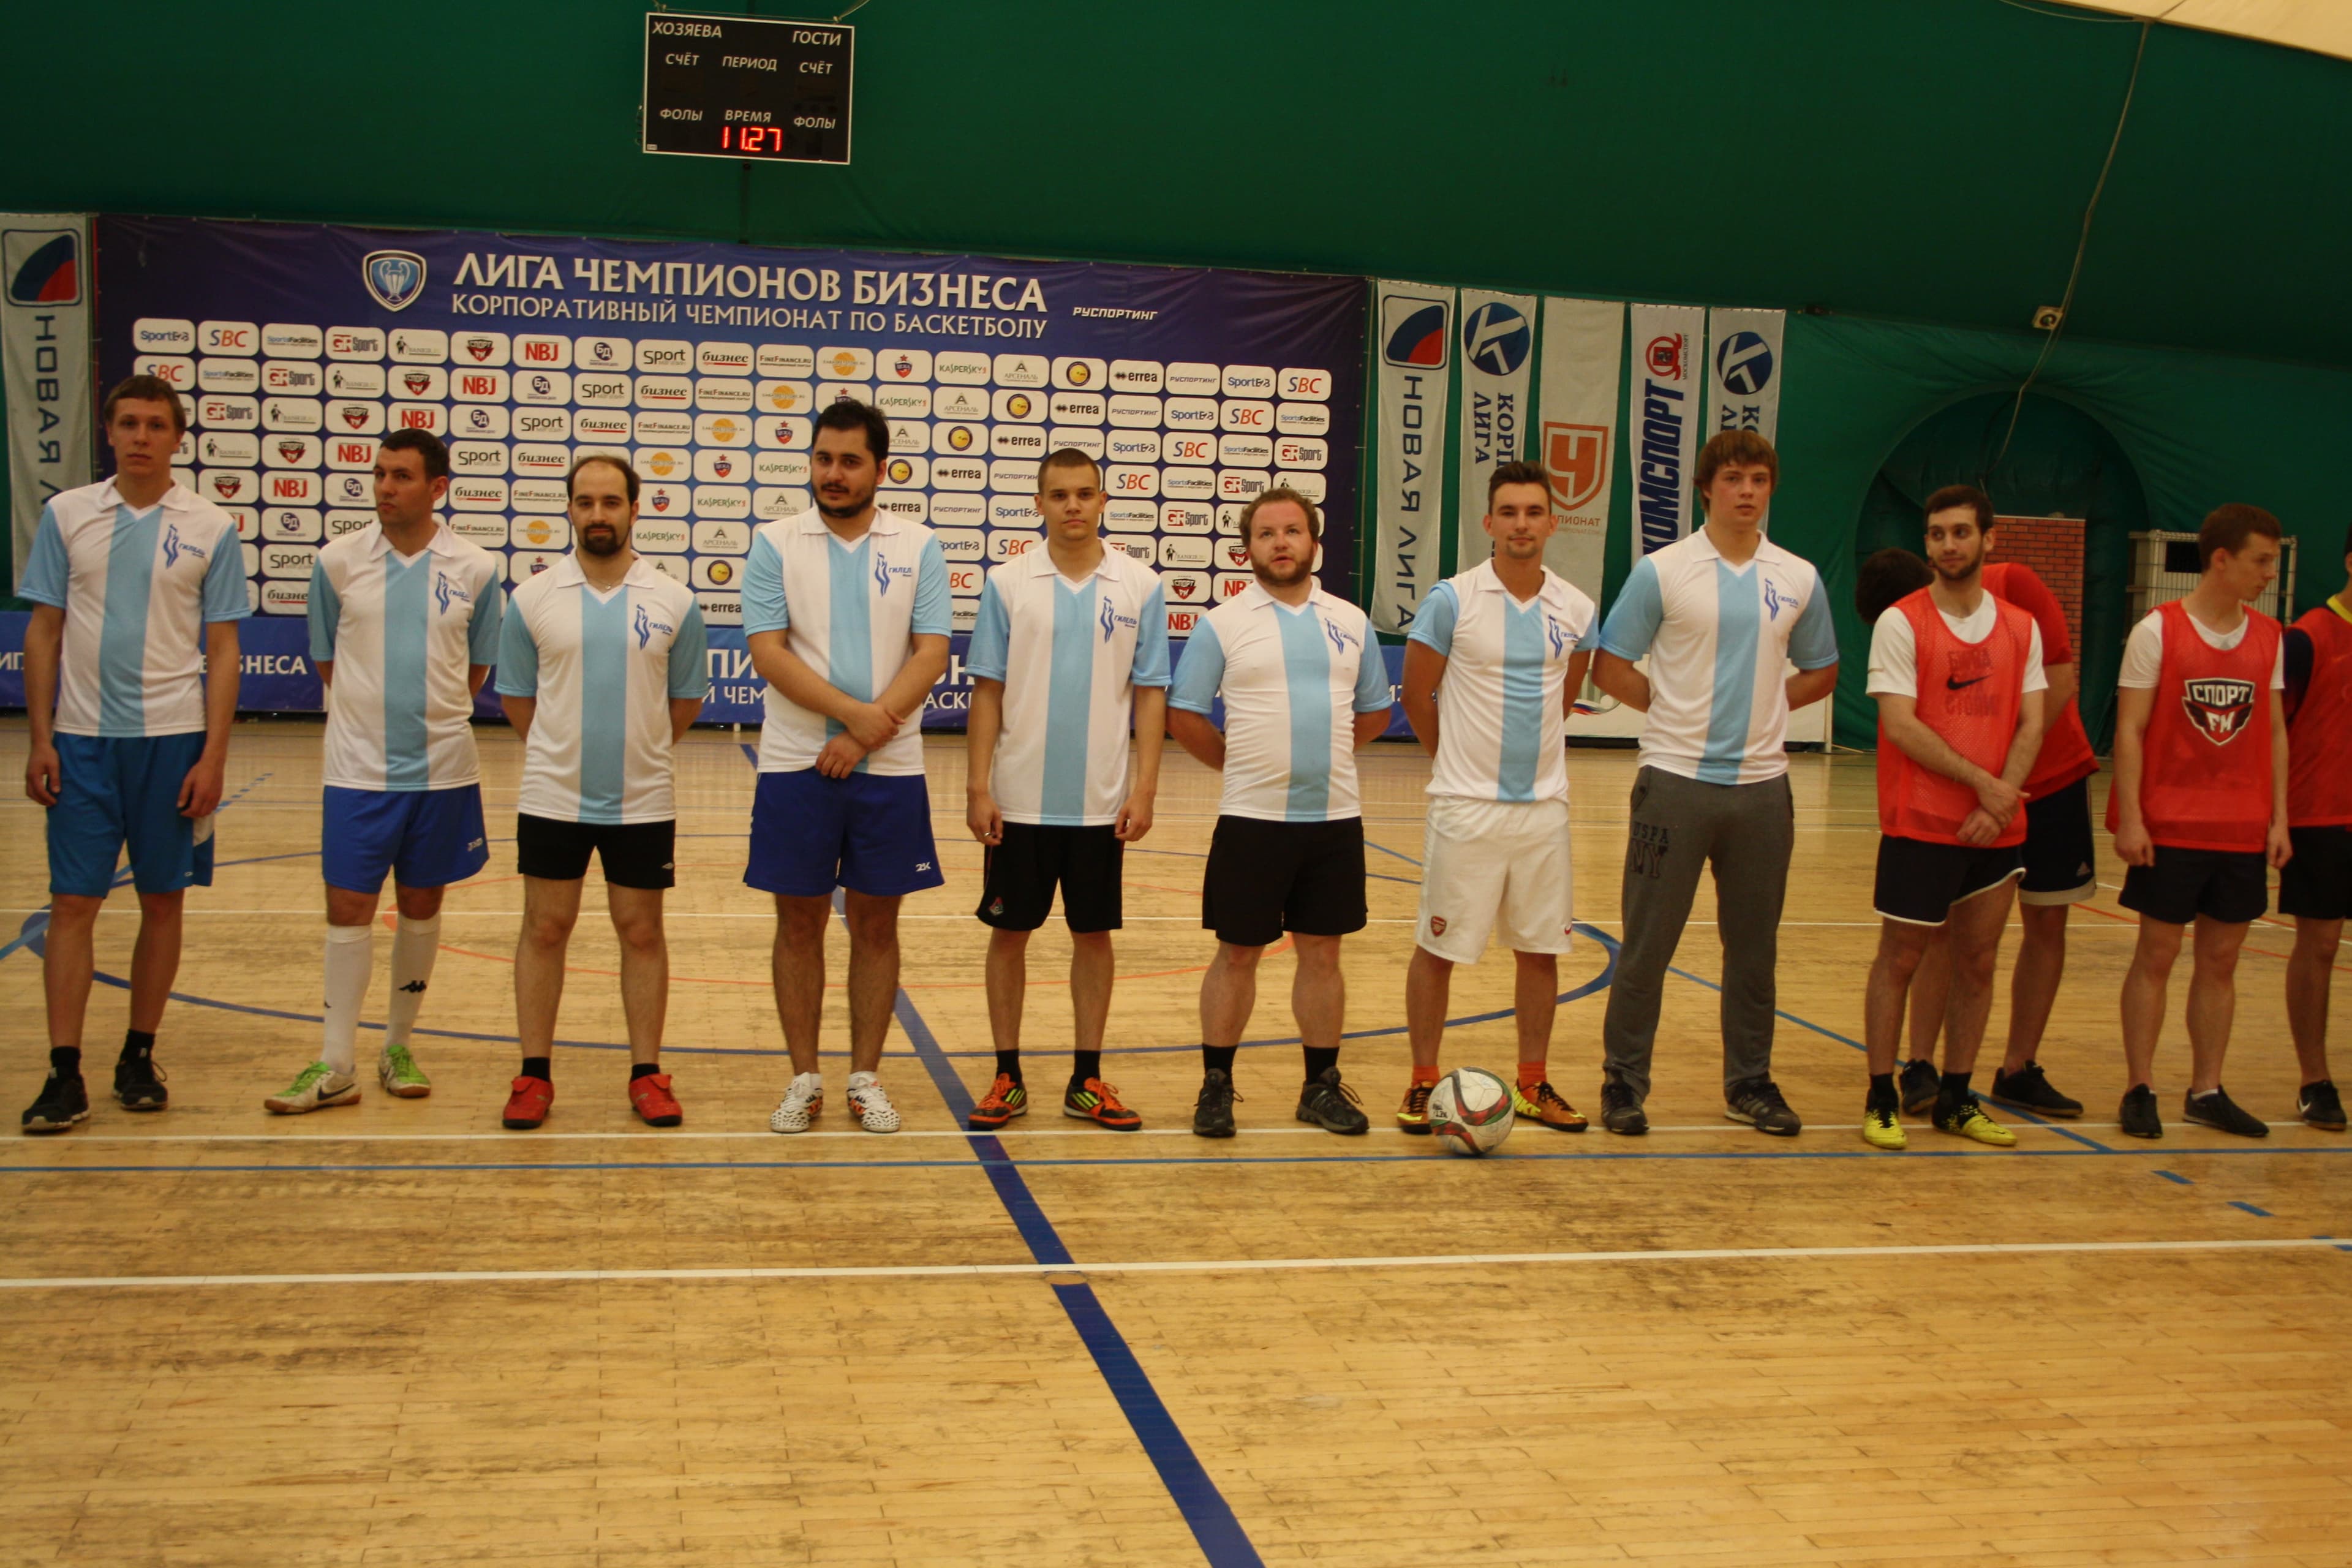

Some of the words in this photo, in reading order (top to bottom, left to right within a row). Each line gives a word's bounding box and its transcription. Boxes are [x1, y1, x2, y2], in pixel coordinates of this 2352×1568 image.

[652, 21, 722, 38] ХОЗЯЕВА
[793, 31, 841, 46] ГОСТИ
[665, 52, 699, 66] СЧЁТ
[722, 56, 777, 72] ПЕРИОД
[799, 61, 832, 74] СЧЁТ
[660, 108, 703, 121] ФОЛЫ
[725, 110, 771, 123] ВРЕМЯ
[794, 117, 836, 129] ФОЛЫ
[453, 253, 565, 290] ЛИГА
[574, 258, 841, 302] ЧЕМПИОНОВ
[853, 270, 1048, 312] БИЗНЕСА
[452, 293, 676, 323] КОРПОРАТИВНЫЙ
[686, 304, 842, 331] ЧЕМПИОНАТ
[850, 311, 886, 333] ПО
[894, 313, 1047, 339] БАСКЕТБОЛУ
[1072, 306, 1159, 321] РУСПОРТИНГ
[209, 330, 248, 347] SBC
[526, 343, 559, 362] NBJ
[643, 349, 685, 364] Sport
[703, 352, 748, 363] бизнес
[1128, 372, 1158, 383] errea
[1287, 377, 1322, 394] SBC
[35, 315, 61, 464] НОВАЯ
[462, 377, 496, 395] NBJ
[582, 383, 625, 399] Sport
[641, 385, 687, 396] бизнес
[1069, 404, 1099, 415] errea
[1230, 409, 1264, 425] SBC
[401, 410, 435, 429] NBJ
[521, 416, 564, 432] Sport
[581, 418, 627, 430] бизнес
[1474, 391, 1490, 464] ЛИГА
[1011, 436, 1041, 447] errea
[1401, 375, 1423, 512] НОВАЯ
[338, 445, 372, 462] NBJ
[458, 450, 501, 466] Sport
[1174, 442, 1208, 458] SBC
[518, 453, 565, 464] бизнес
[951, 469, 981, 479] errea
[1117, 473, 1152, 490] SBC
[274, 480, 308, 499] NBJ
[455, 487, 502, 499] бизнес
[891, 502, 921, 513] errea
[1558, 514, 1601, 526] ПИОНАТ
[997, 539, 1033, 555] SBC
[270, 552, 314, 569] Sport
[950, 572, 974, 589] BC
[1396, 525, 1417, 628] ЛИГА
[268, 589, 307, 601] бизне
[711, 602, 741, 612] errea
[2192, 684, 2250, 707] СПОРТ
[2206, 710, 2235, 733] FM
